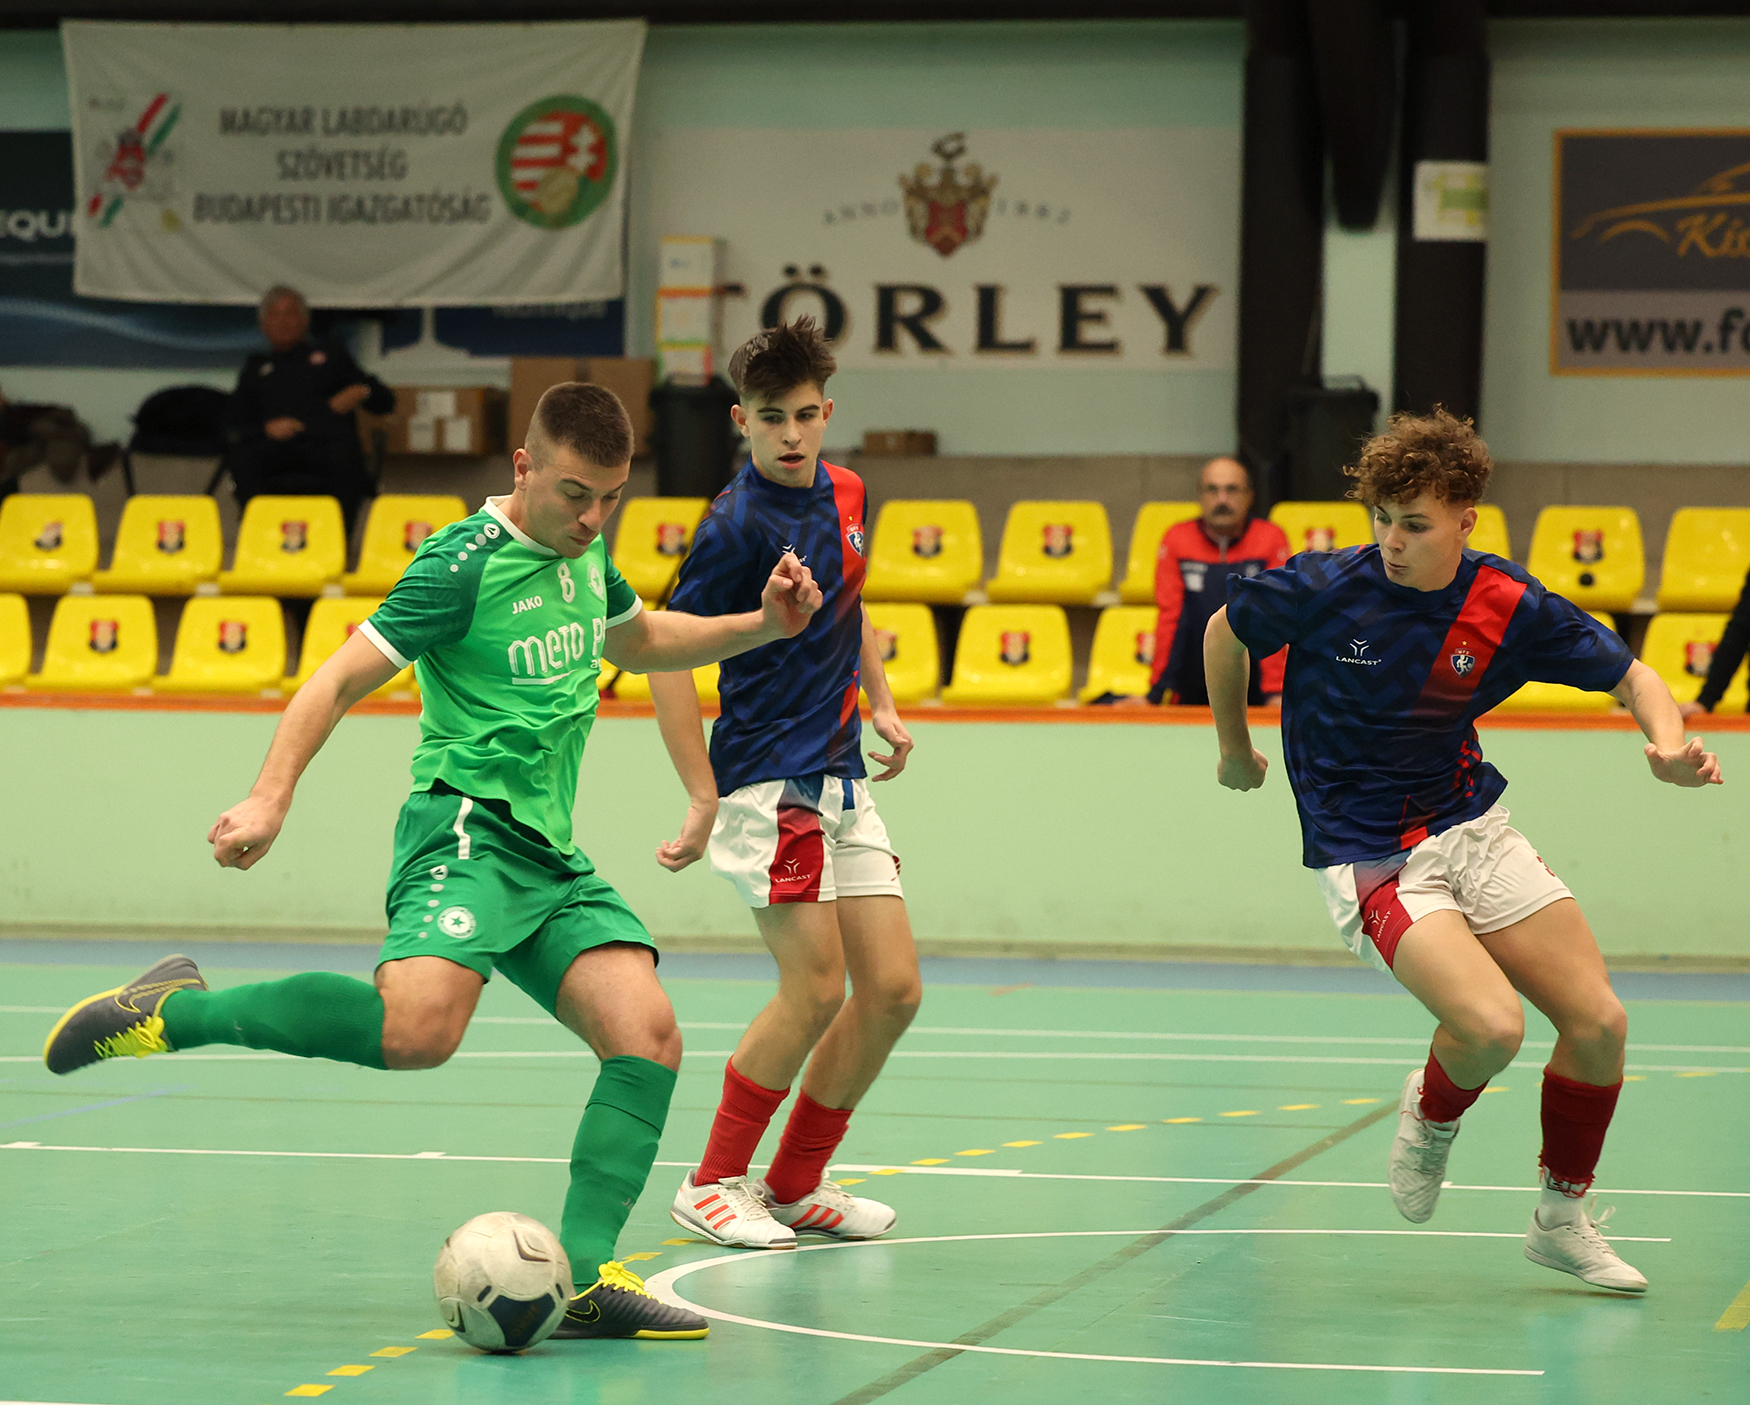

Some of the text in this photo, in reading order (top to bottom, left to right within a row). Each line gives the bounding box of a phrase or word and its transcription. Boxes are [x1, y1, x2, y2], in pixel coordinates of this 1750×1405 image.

[218, 105, 315, 136] MAGYAR
[193, 193, 322, 224] BUDAPESTI
[556, 561, 576, 604] 8
[511, 595, 544, 615] JAKO
[774, 873, 812, 884] LANCAST
